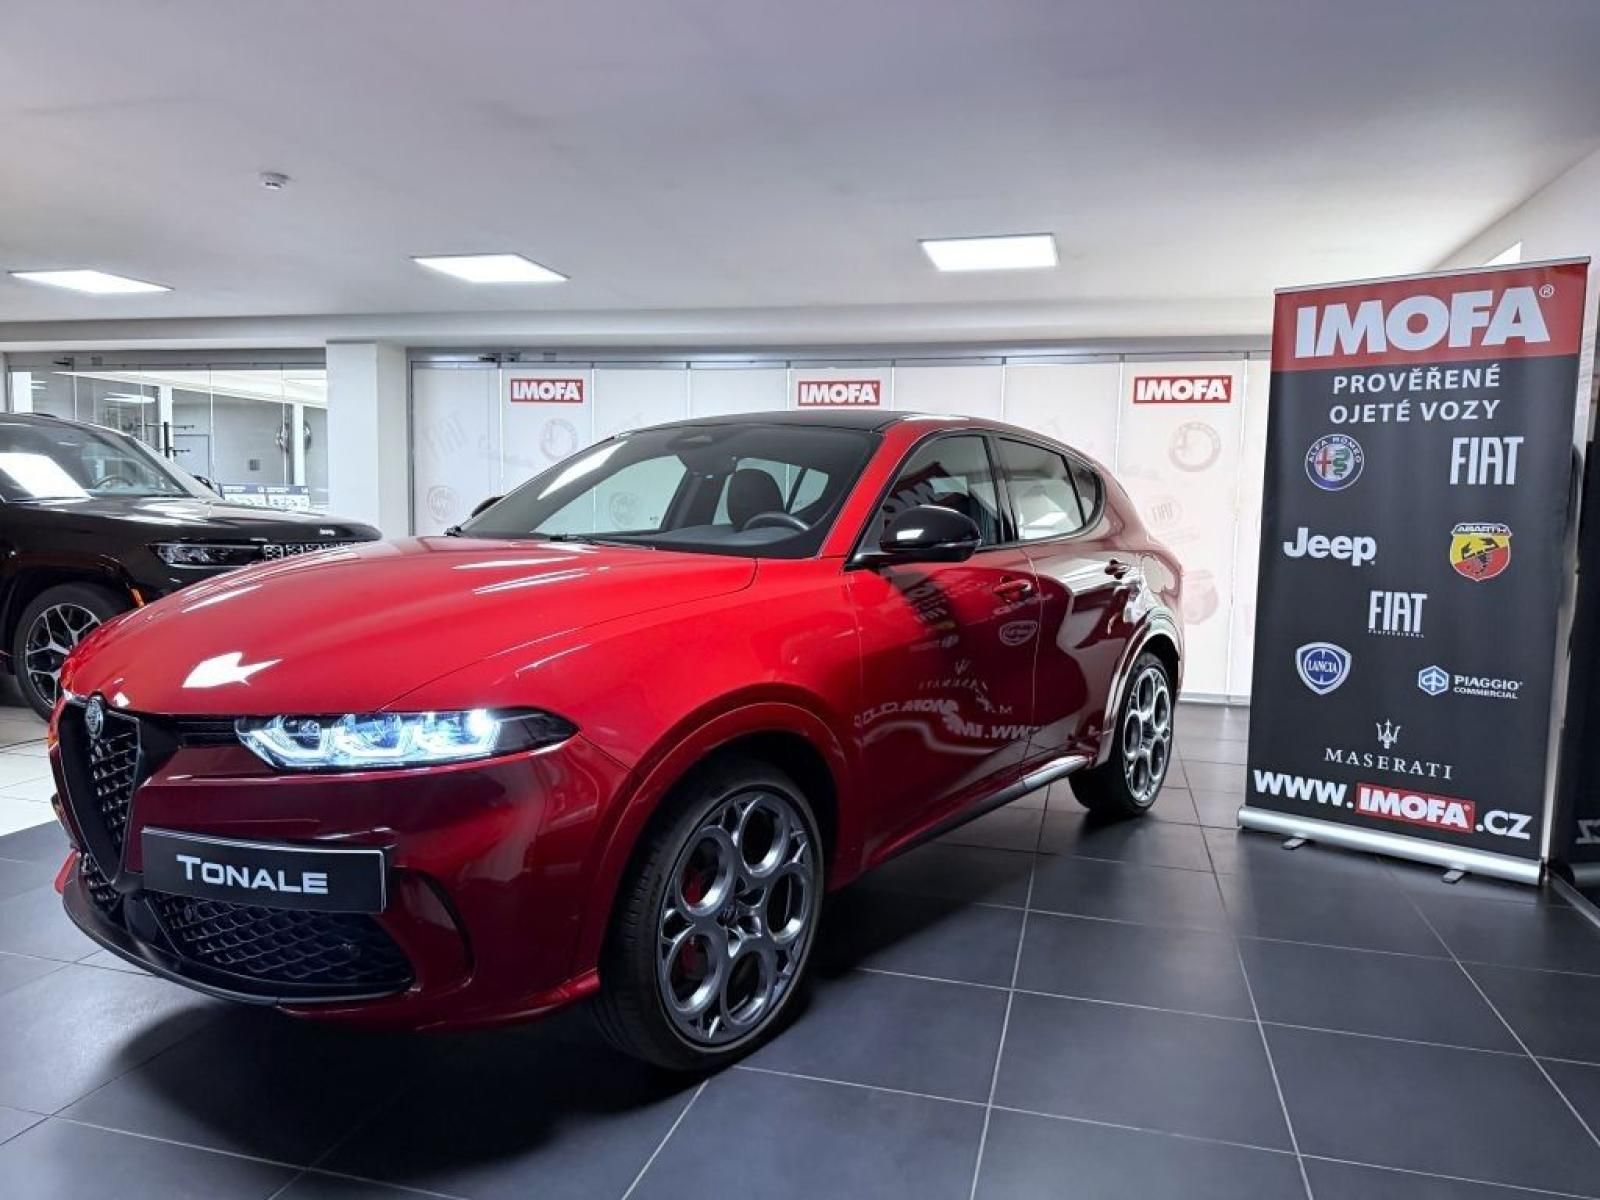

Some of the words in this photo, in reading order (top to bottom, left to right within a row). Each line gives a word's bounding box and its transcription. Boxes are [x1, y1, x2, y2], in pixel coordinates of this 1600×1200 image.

[513, 381, 581, 401] IMOFA
[800, 382, 876, 403] IMOFA
[1136, 378, 1228, 402] IMOFA
[1333, 364, 1501, 395] PROVĚŘENÉ
[1329, 400, 1411, 425] OJETÉ
[1420, 399, 1501, 422] VOZY
[1450, 435, 1524, 486] FIAT
[1283, 527, 1377, 567] Jeep
[1368, 590, 1428, 633] FIAT
[1307, 659, 1338, 673] LANCIA
[1453, 687, 1518, 699] COMMERCIAL
[1454, 674, 1520, 690] PIAGGIO
[1325, 748, 1452, 780] MASERATI
[176, 854, 329, 895] TONALE
